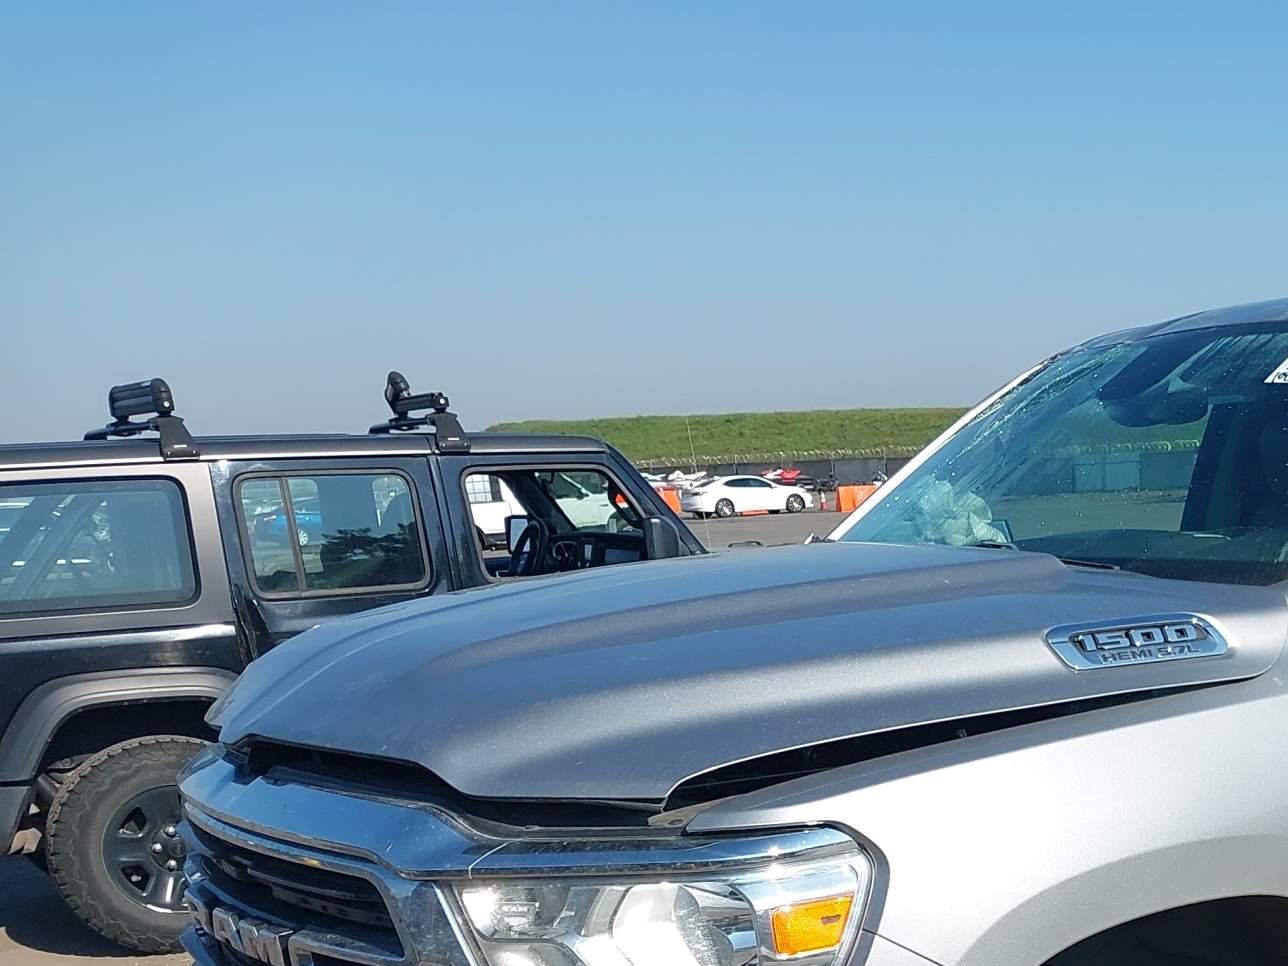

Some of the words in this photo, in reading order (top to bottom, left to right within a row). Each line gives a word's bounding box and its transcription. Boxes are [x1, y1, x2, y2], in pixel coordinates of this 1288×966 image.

[1078, 623, 1198, 652] 1500
[1101, 648, 1153, 663] HEMI
[1156, 644, 1201, 658] 5.7L
